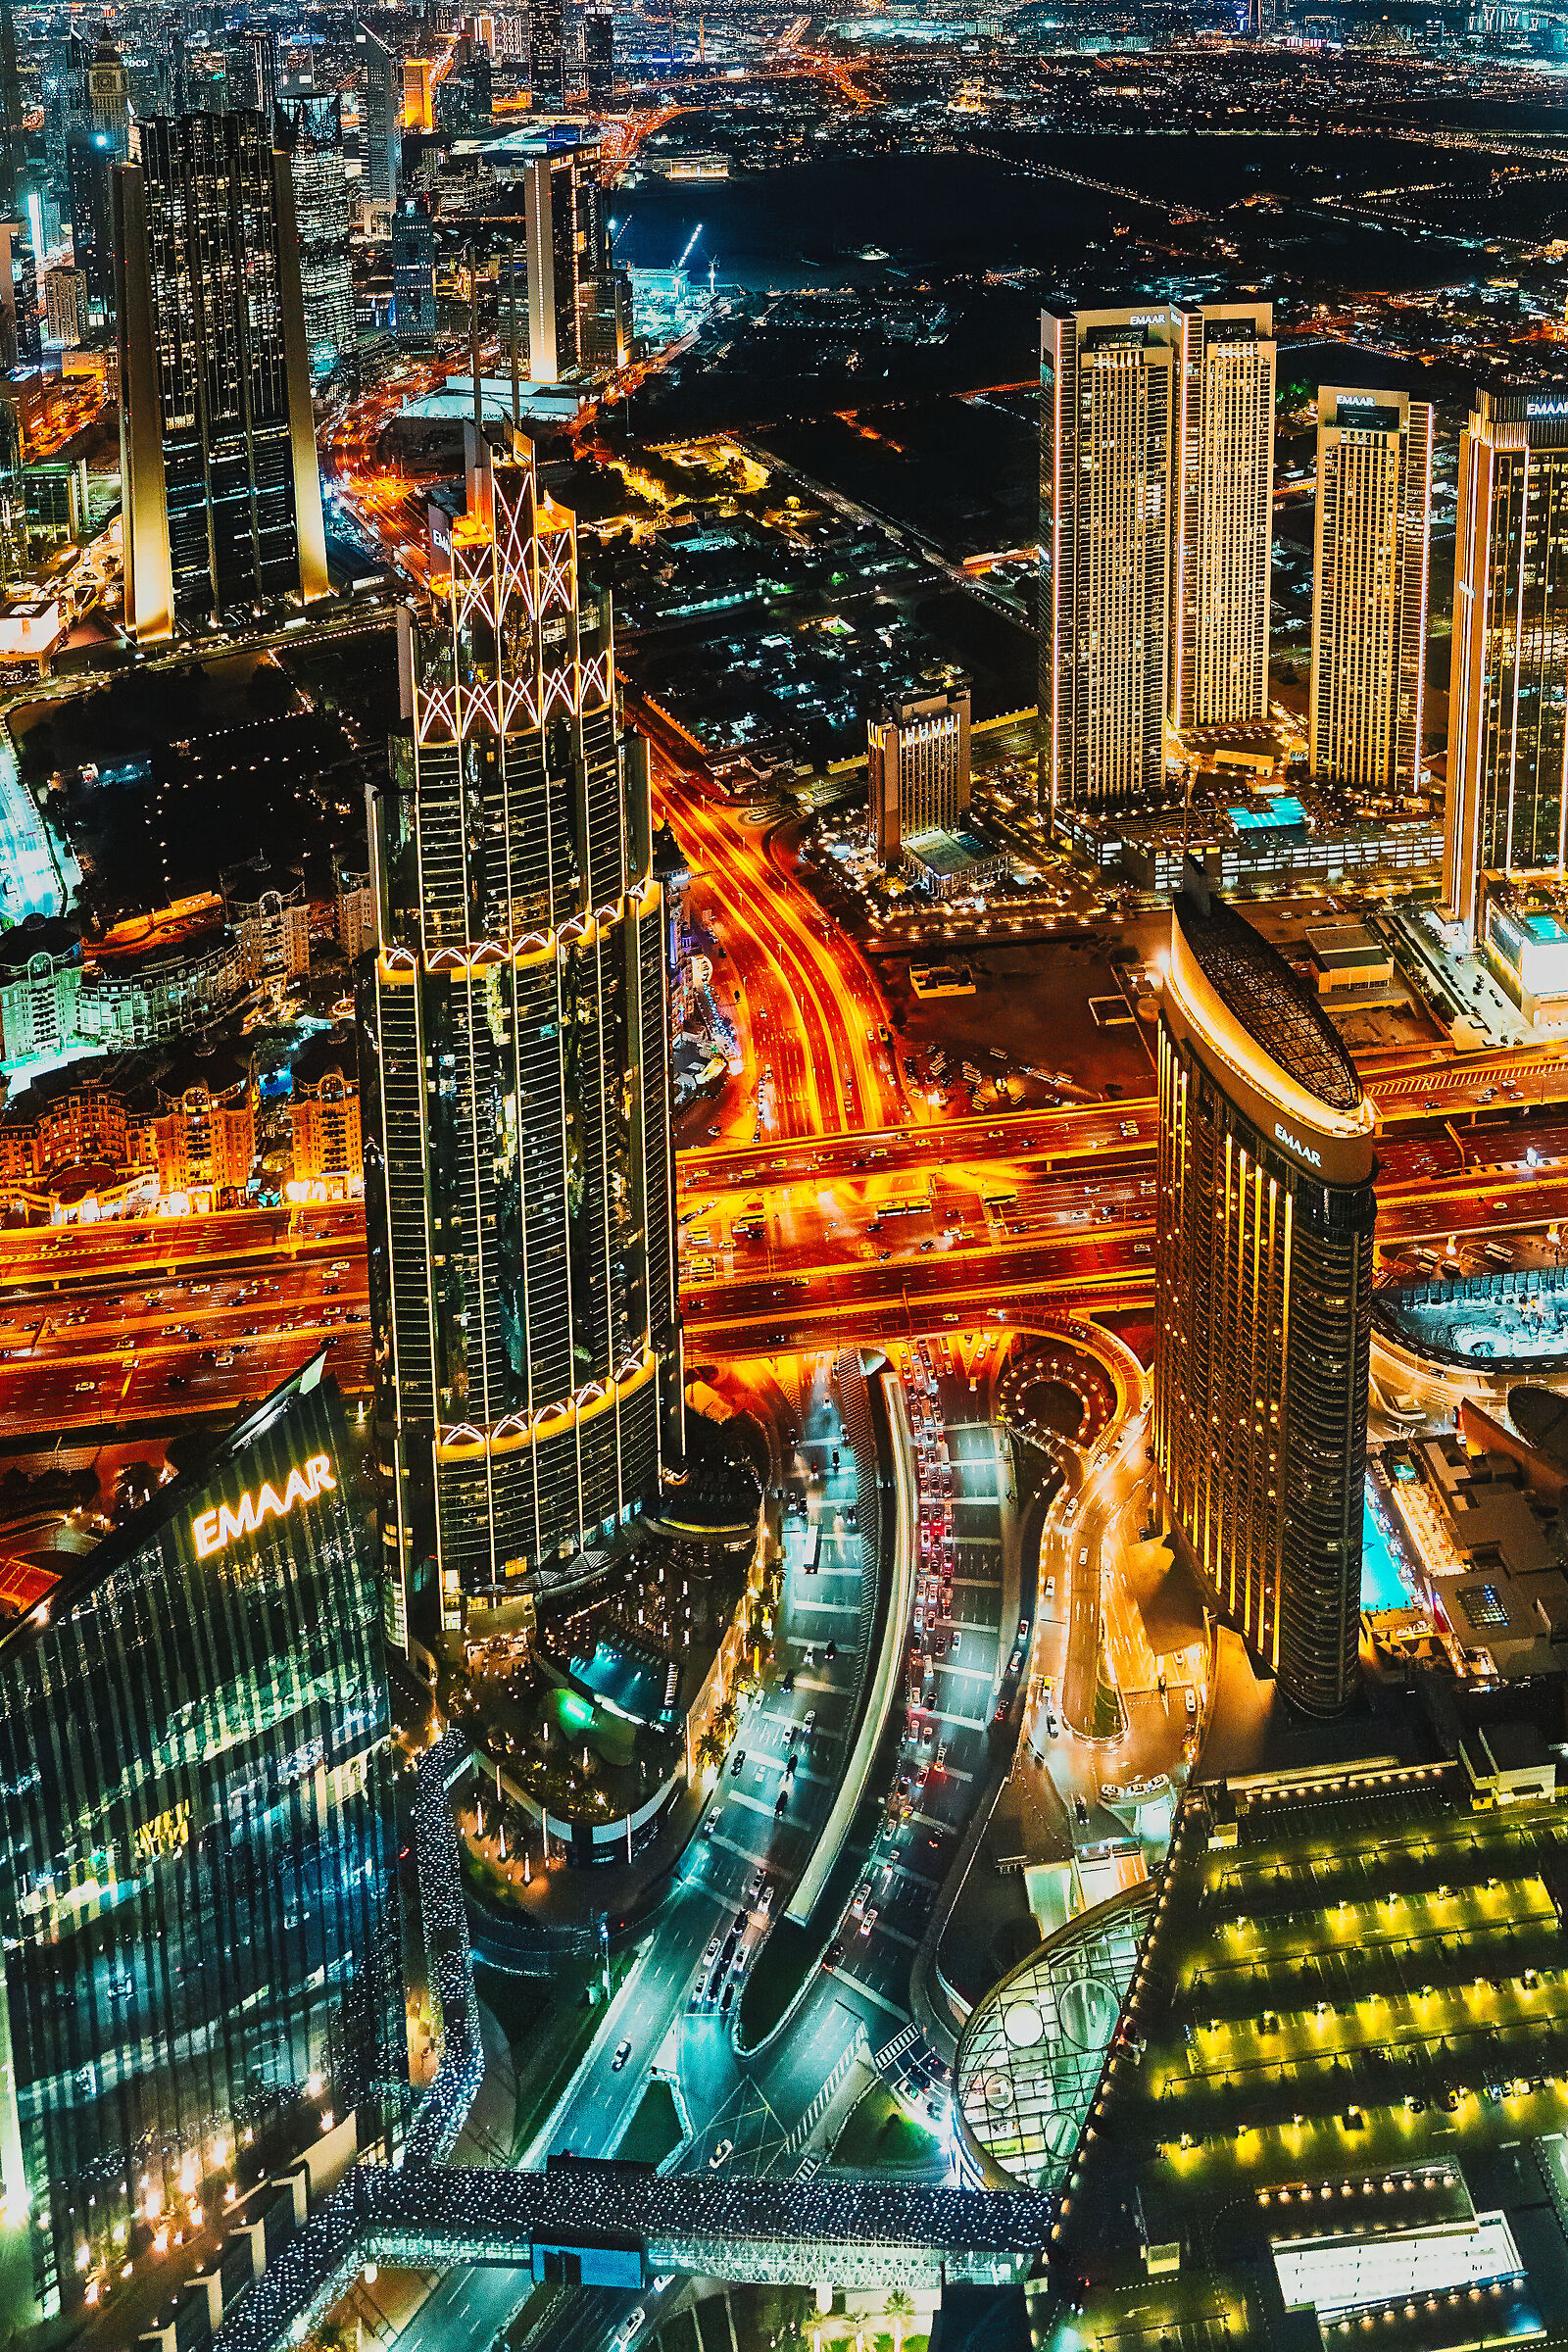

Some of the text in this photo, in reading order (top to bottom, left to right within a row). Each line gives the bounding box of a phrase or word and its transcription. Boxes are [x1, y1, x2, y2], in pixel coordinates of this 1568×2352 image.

[1130, 314, 1166, 325] EMAAR
[1336, 394, 1375, 407] EMAAR
[1275, 1122, 1322, 1167] EMAAR
[193, 1454, 337, 1558] EMAAR
